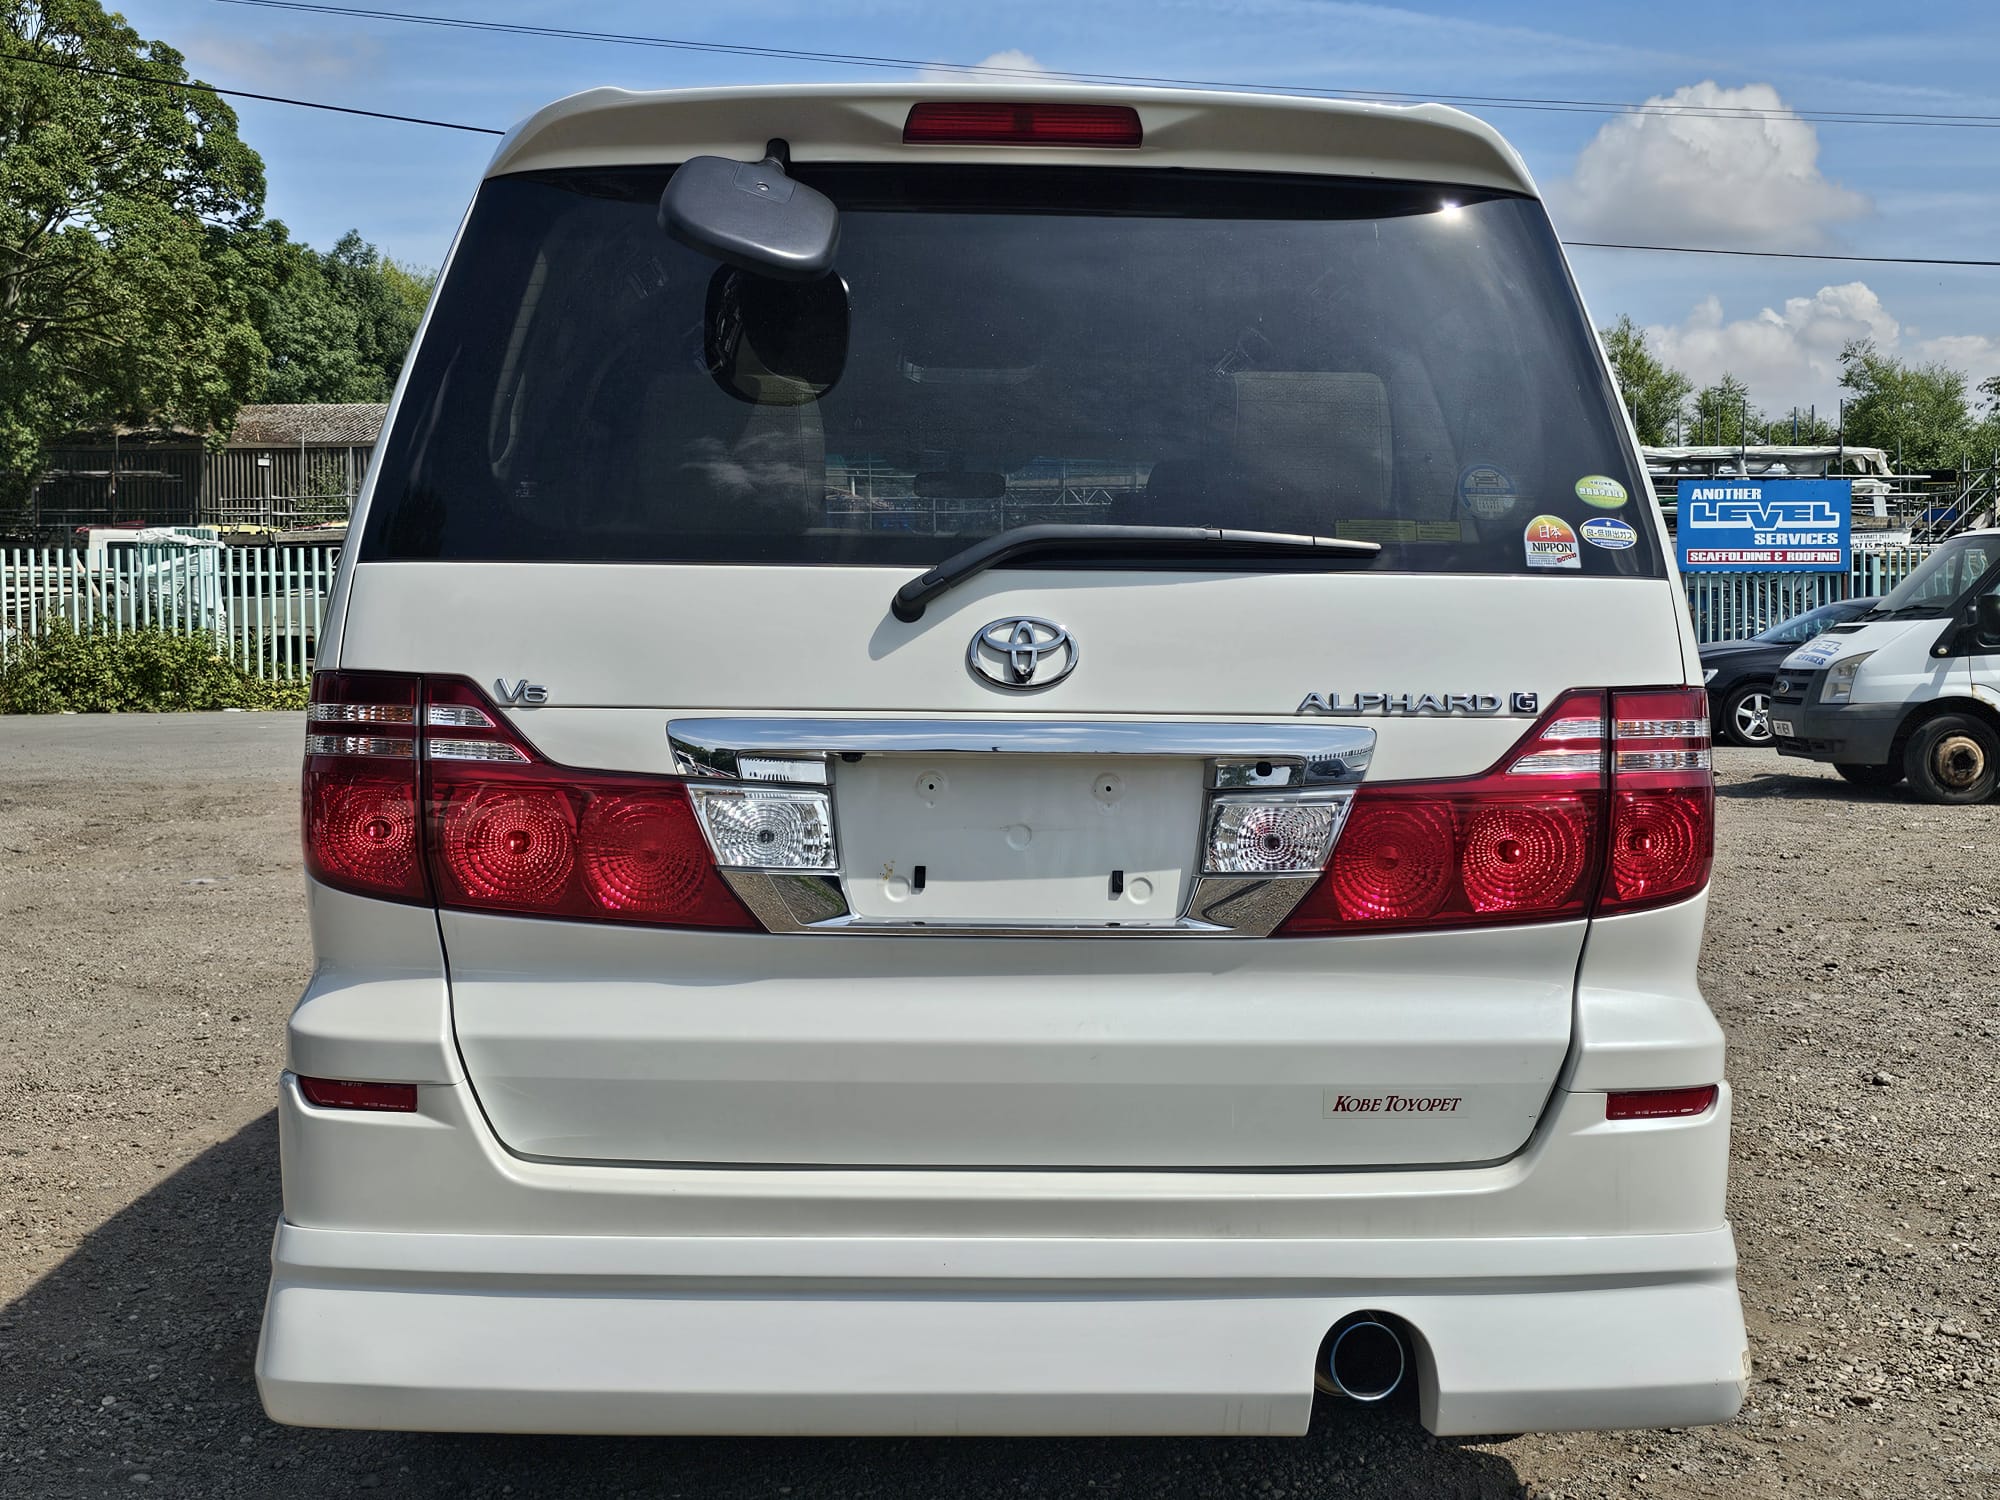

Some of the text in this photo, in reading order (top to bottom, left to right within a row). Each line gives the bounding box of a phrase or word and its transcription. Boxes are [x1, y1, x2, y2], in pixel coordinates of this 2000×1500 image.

[1691, 488, 1762, 500] ANOTHER
[1690, 502, 1840, 531] LEVEL
[1539, 525, 1562, 539] 日本
[1754, 533, 1839, 545] SERVICES
[1532, 542, 1573, 552] NIPPON
[1690, 551, 1838, 562] SCAFFOLDING & ROOFING
[497, 679, 548, 703] V6
[1297, 692, 1538, 713] ALPHARD G
[1333, 1095, 1462, 1112] KOBE TOYOPET
